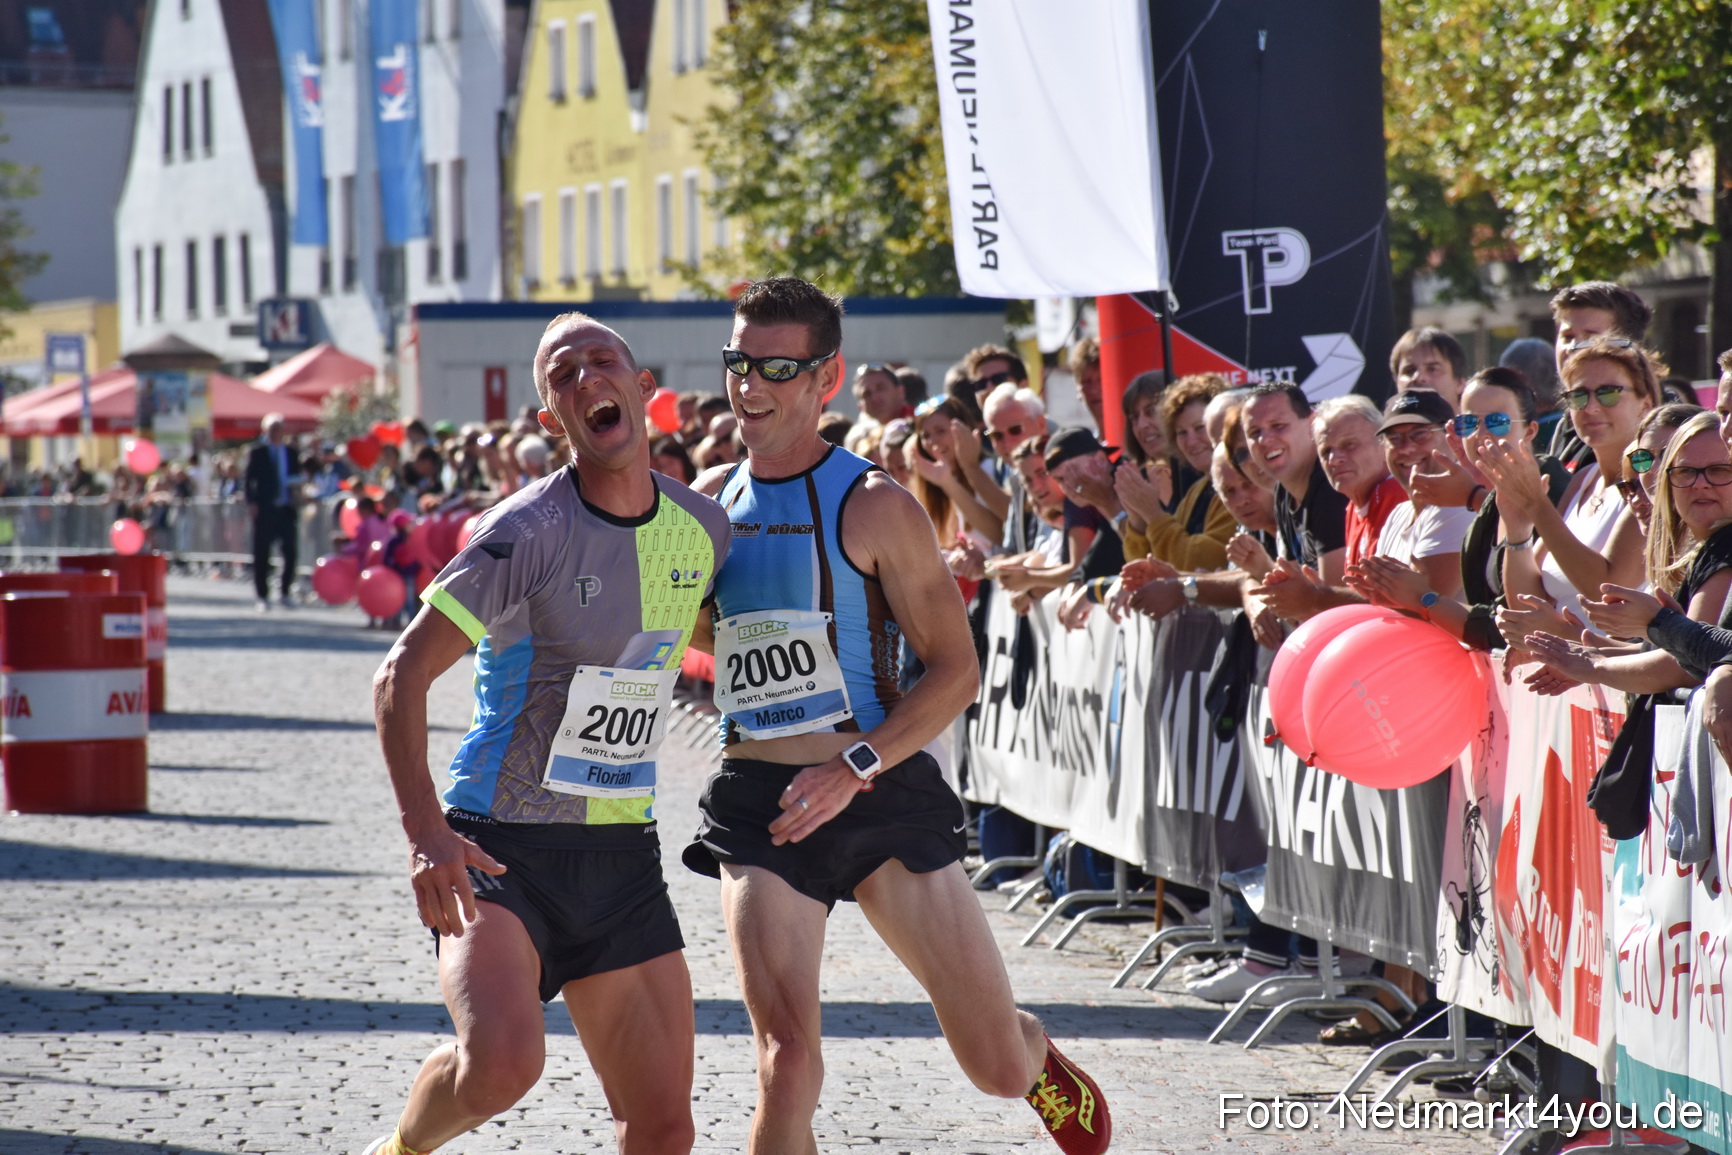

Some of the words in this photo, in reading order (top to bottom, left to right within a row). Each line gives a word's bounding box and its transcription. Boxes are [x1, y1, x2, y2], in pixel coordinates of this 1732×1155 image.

[1247, 366, 1297, 384] NEXT
[737, 620, 789, 641] BOCK
[727, 639, 817, 694] 2000
[611, 681, 659, 697] BOCK
[737, 694, 764, 706] PARTL
[765, 686, 804, 700] Neumarkt
[578, 704, 659, 747] 2001
[755, 706, 806, 727] Marco
[581, 746, 609, 759] PARTL
[586, 765, 632, 786] Florian
